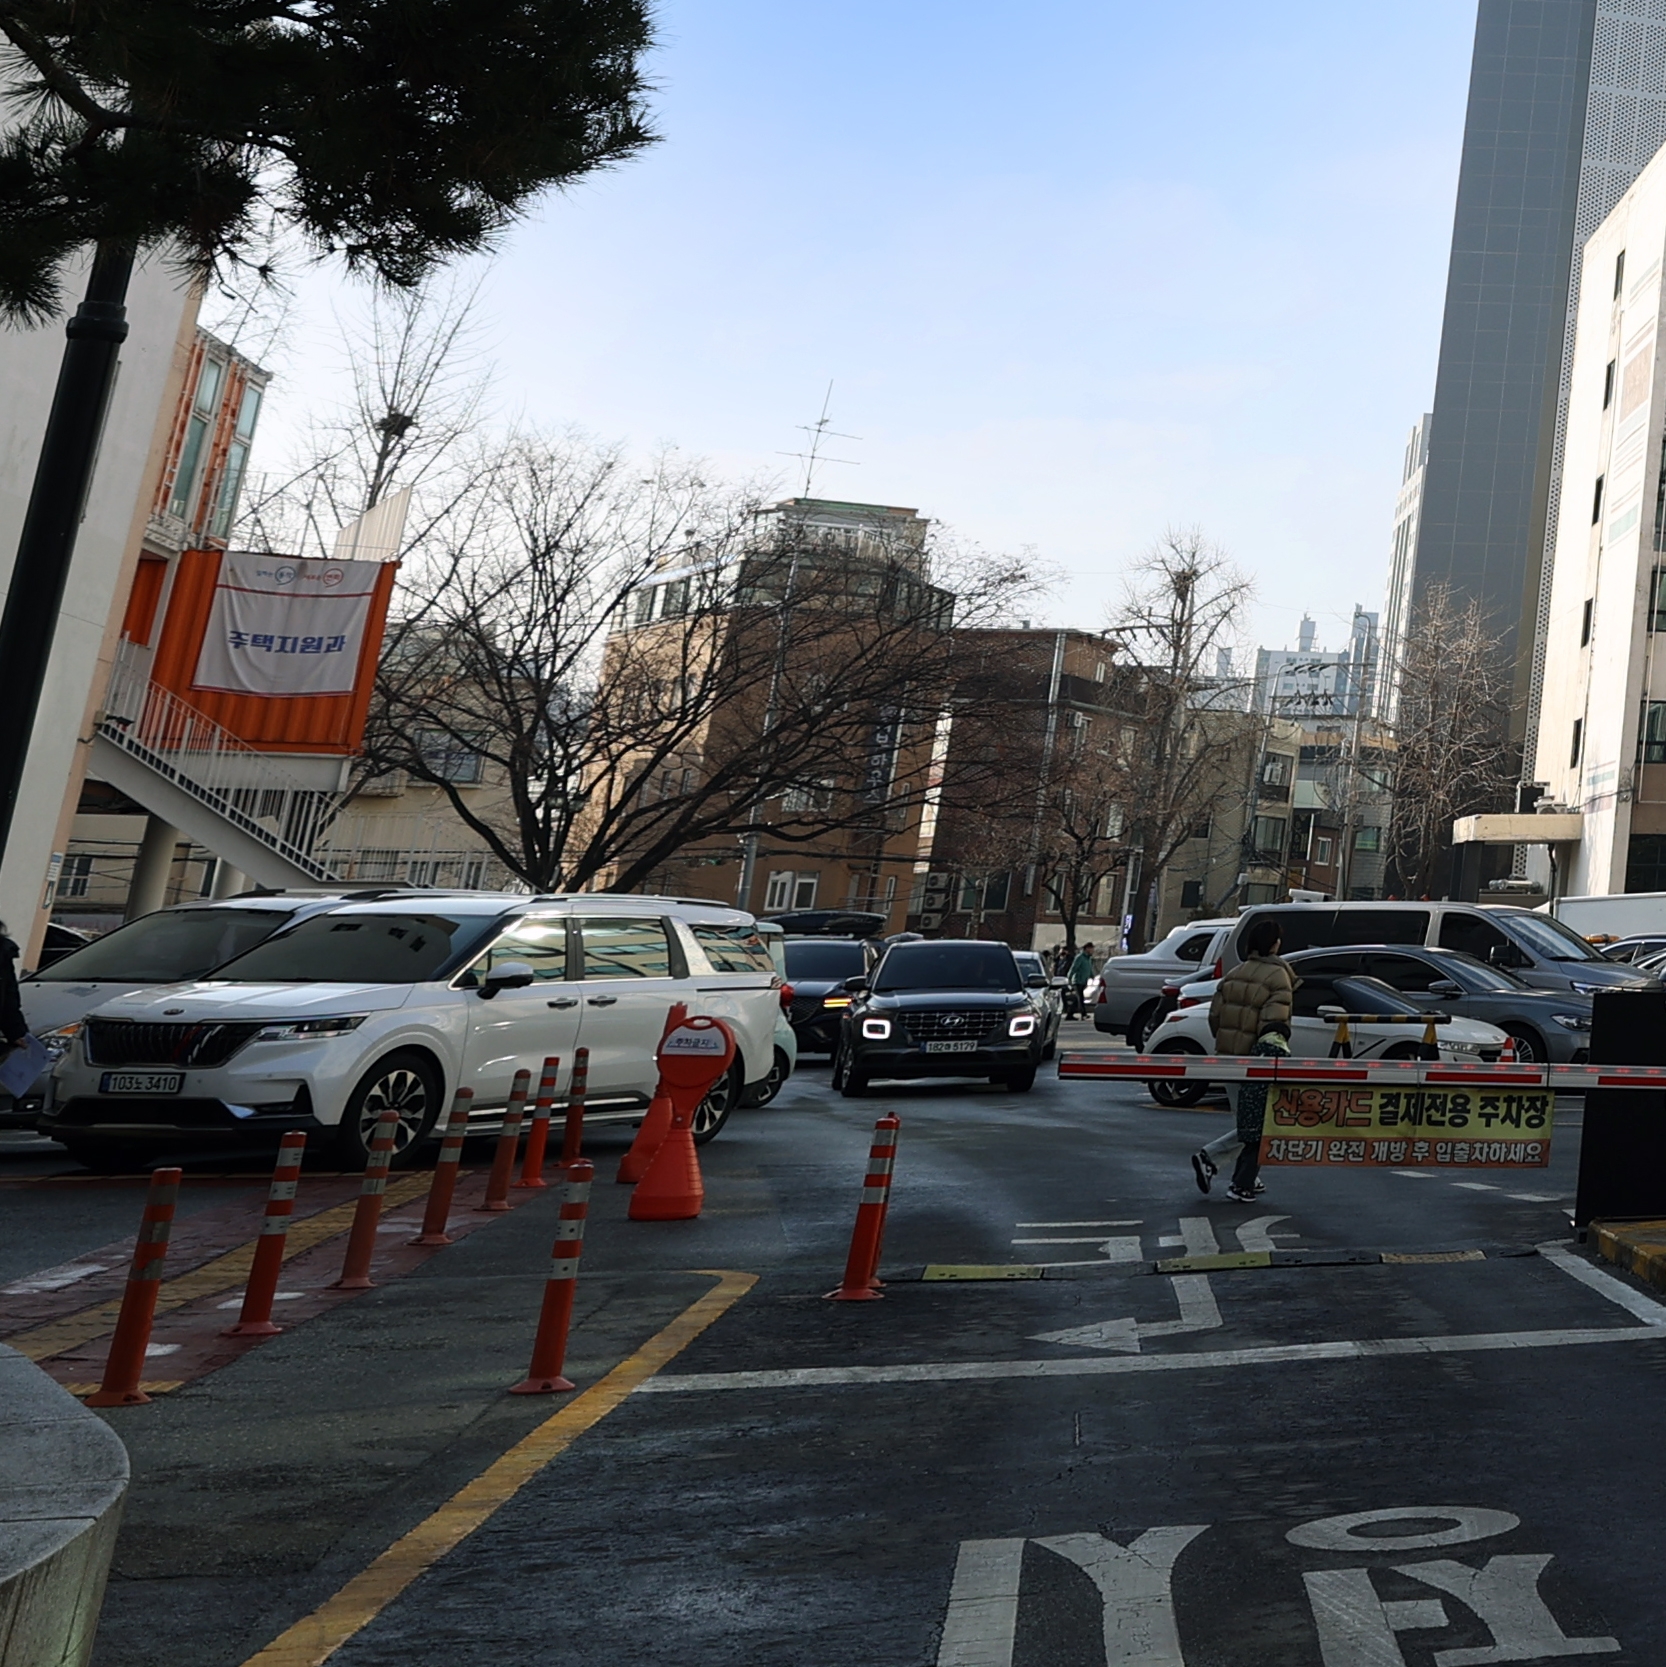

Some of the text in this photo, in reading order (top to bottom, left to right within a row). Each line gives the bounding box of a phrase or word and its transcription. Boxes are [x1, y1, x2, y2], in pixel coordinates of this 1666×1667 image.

[228, 630, 347, 654] 주택지원과
[145, 1076, 177, 1091] 3410
[1273, 1088, 1549, 1129] 신용카드 결제전용 주차장
[1266, 1138, 1544, 1164] 차단기 완전 개방 후 입출차하세요
